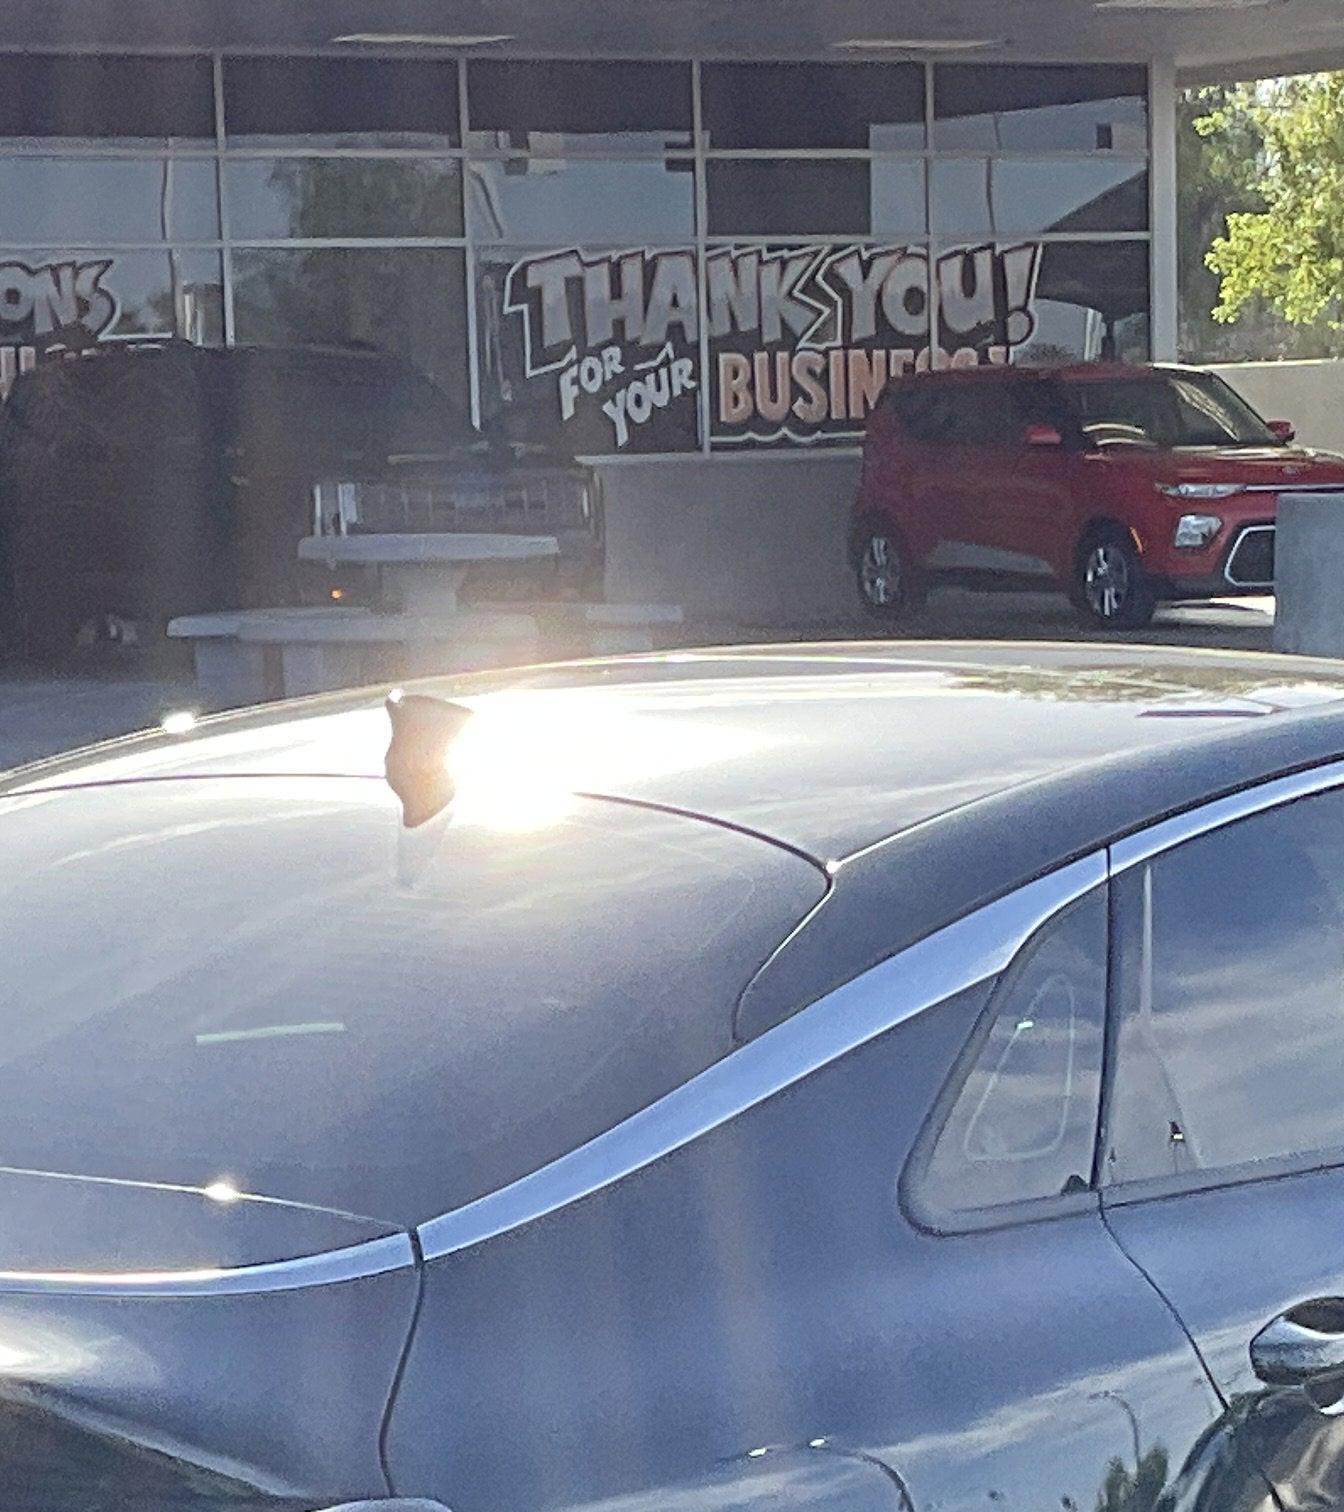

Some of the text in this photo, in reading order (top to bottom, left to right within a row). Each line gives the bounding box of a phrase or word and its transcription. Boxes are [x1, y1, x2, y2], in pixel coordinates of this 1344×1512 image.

[526, 246, 1034, 349] THANK YOU!
[559, 345, 625, 421] FOR
[602, 346, 1007, 448] YOUR BUSIN
